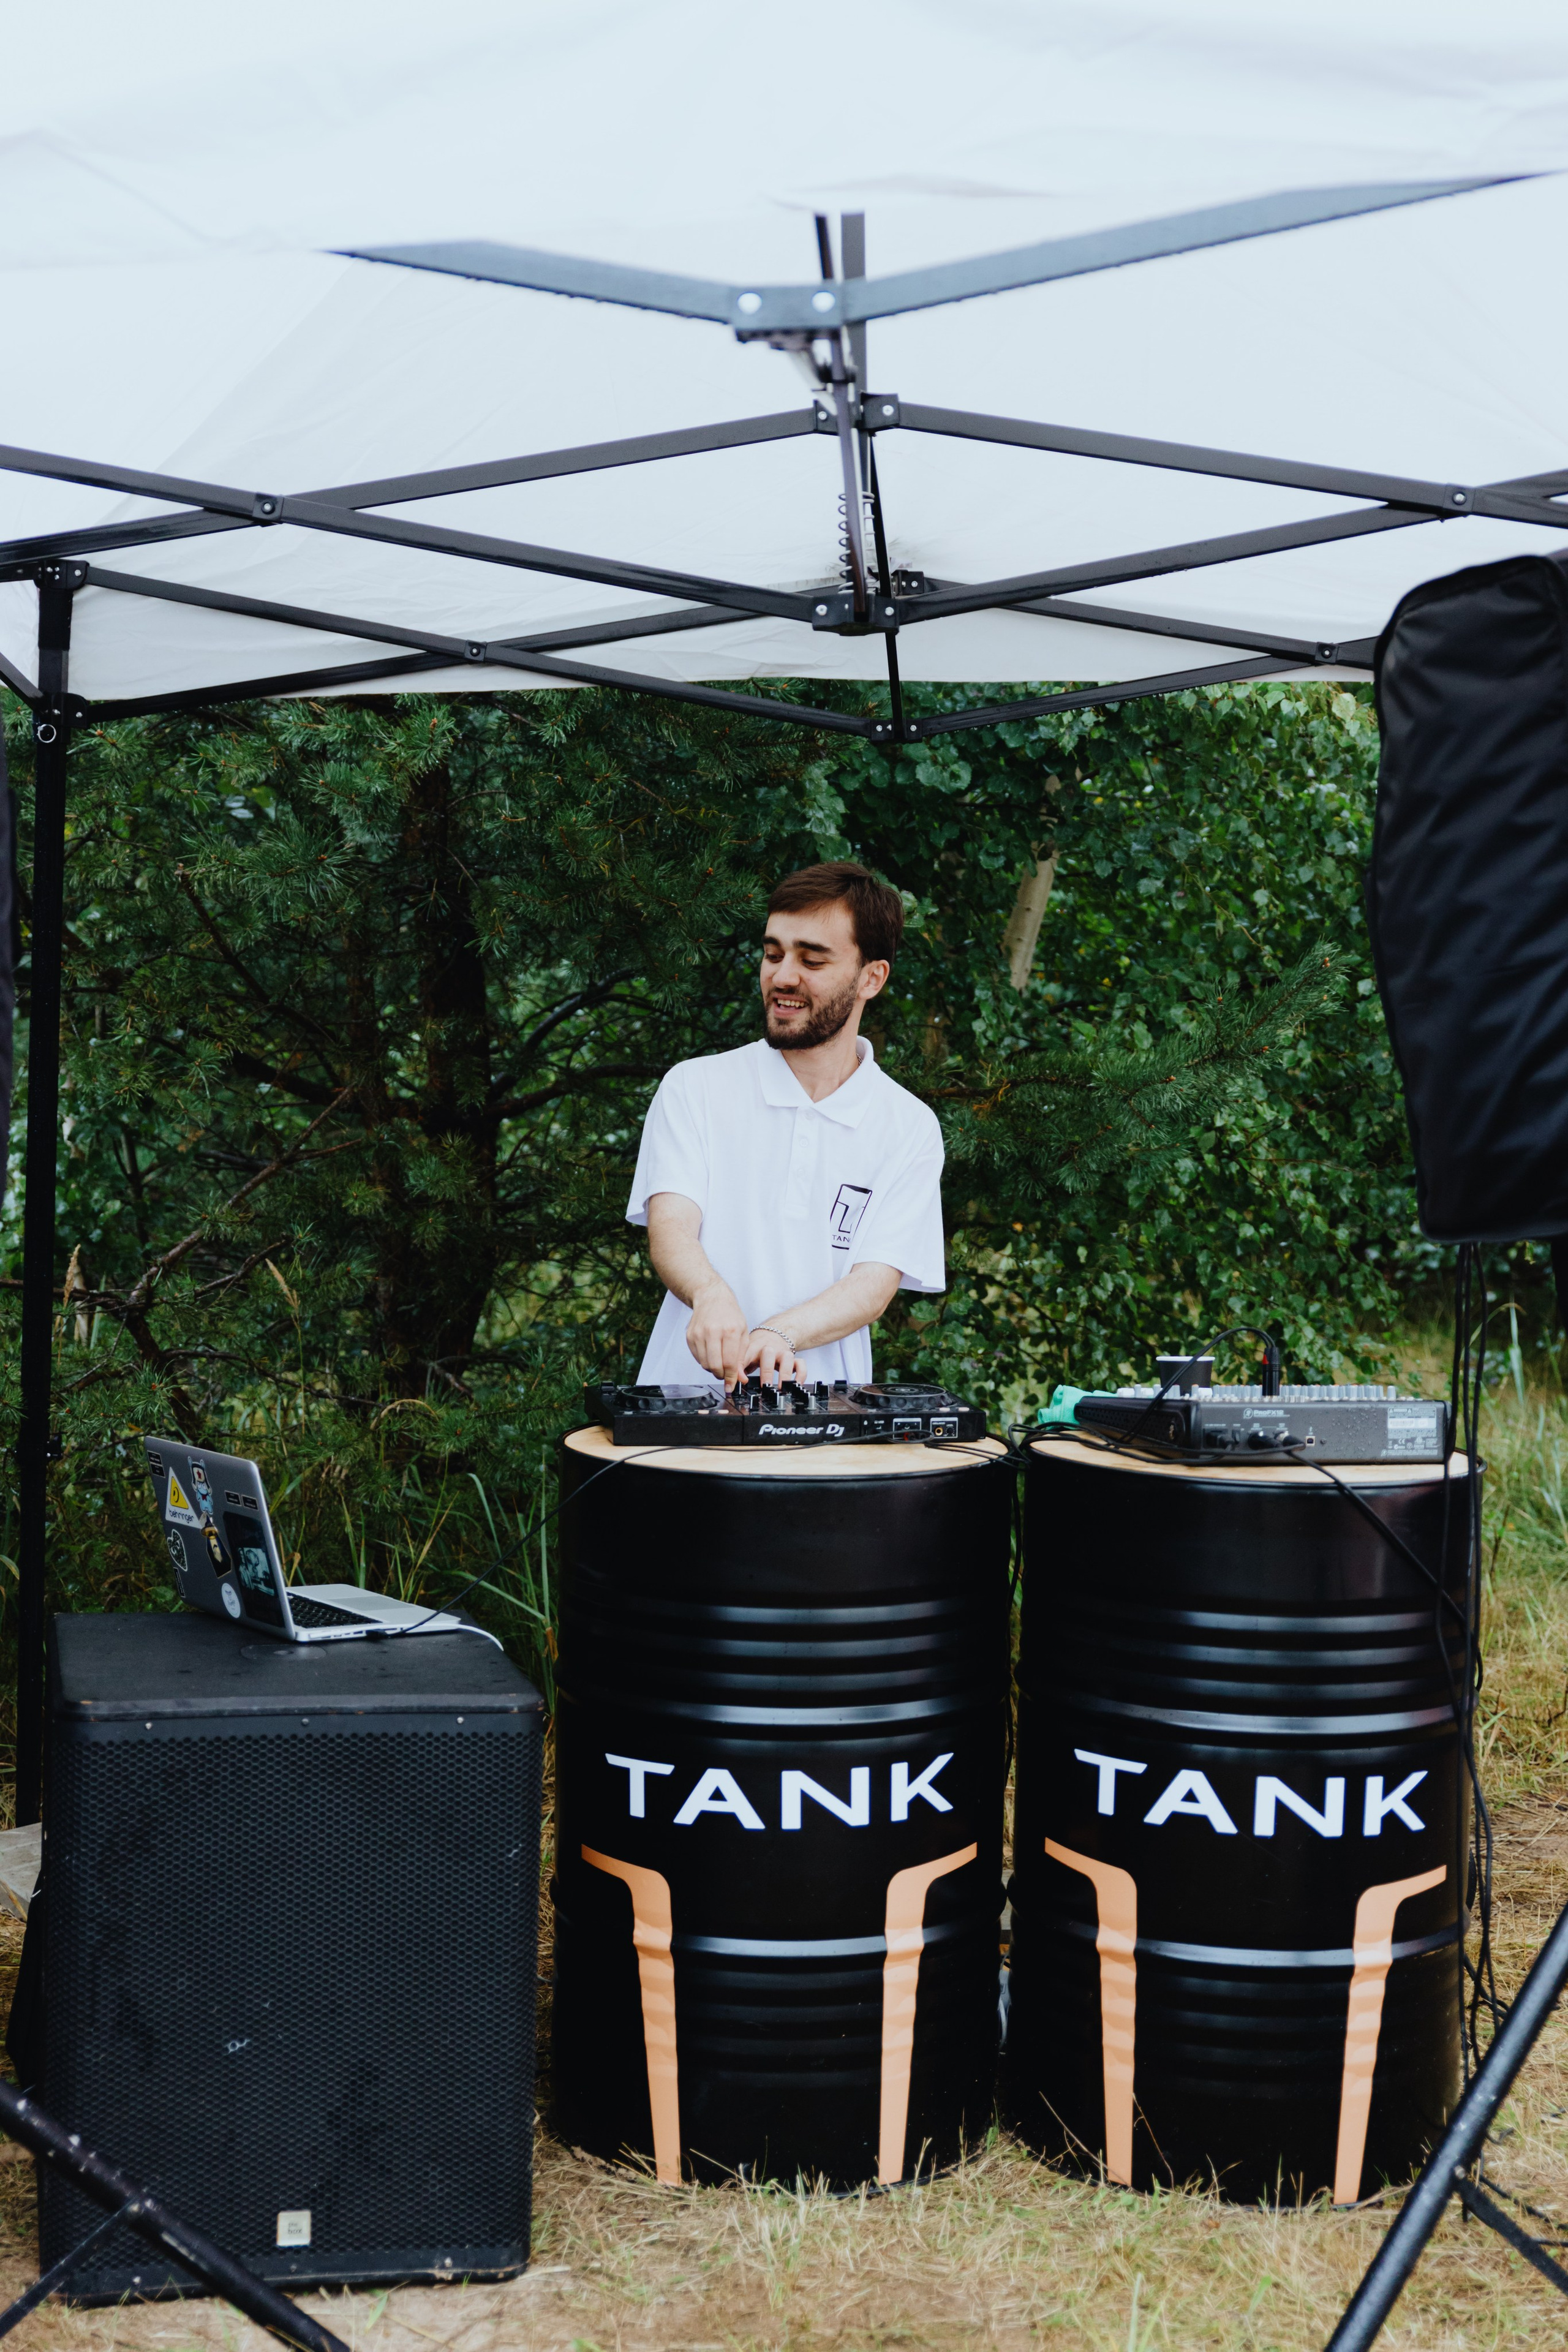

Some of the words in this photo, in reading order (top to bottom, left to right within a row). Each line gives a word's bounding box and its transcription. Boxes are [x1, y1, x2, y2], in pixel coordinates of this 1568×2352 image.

[759, 1424, 824, 1435] Pioneer
[168, 1508, 194, 1523] behringer
[605, 1752, 955, 1830] TANK
[1074, 1748, 1428, 1838] TANK
